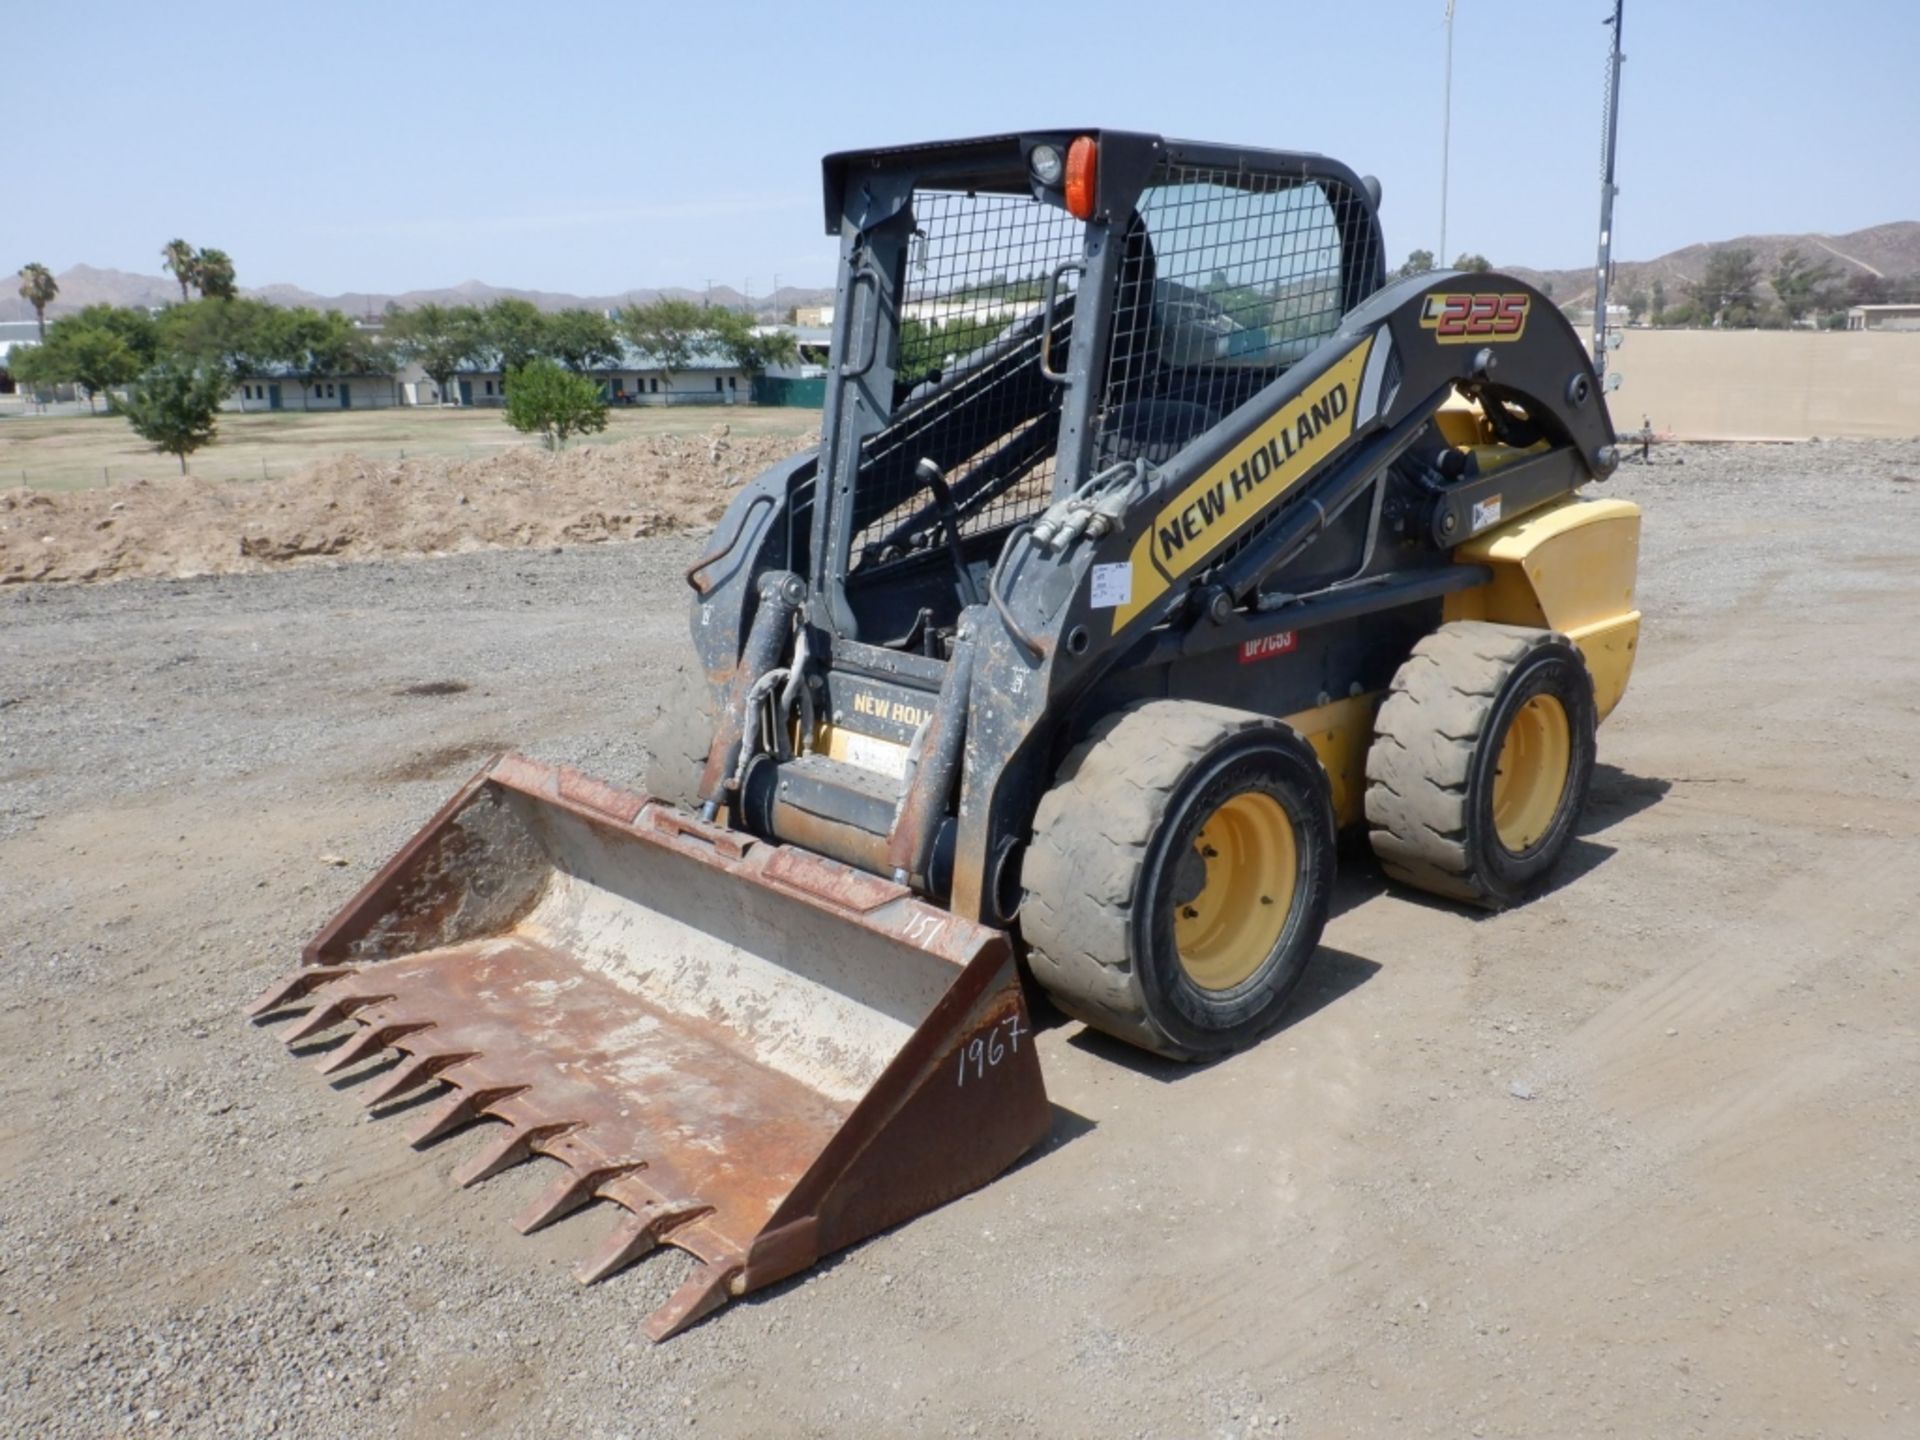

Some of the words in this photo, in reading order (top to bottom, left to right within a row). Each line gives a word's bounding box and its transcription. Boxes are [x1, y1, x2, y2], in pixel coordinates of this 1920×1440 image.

[1158, 479, 1226, 561] NEW
[1229, 381, 1349, 503] HOLLAND
[854, 692, 890, 719] NEW
[903, 910, 946, 950] 151
[957, 1012, 1028, 1087] 1967
